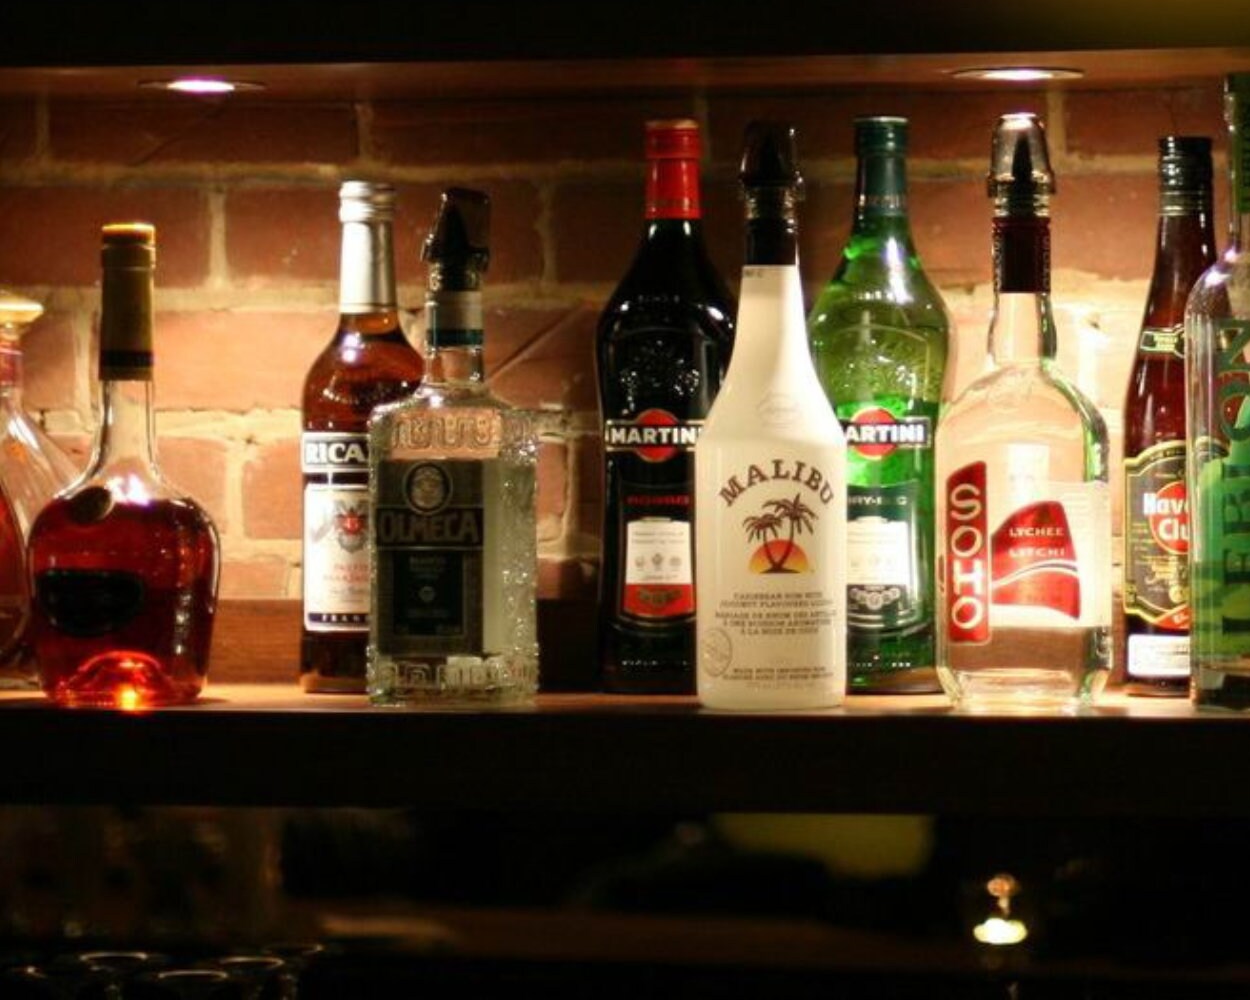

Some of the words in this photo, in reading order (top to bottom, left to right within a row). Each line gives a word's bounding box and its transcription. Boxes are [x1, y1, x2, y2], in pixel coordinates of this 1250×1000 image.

[846, 424, 924, 443] ARTINI
[305, 442, 367, 463] RICA
[719, 459, 834, 507] MALIBU
[1143, 492, 1190, 516] Hav
[380, 512, 479, 543] OLMECA
[1009, 527, 1065, 537] LYCHEE
[1159, 517, 1190, 541] Clu
[950, 483, 983, 629] SOHO
